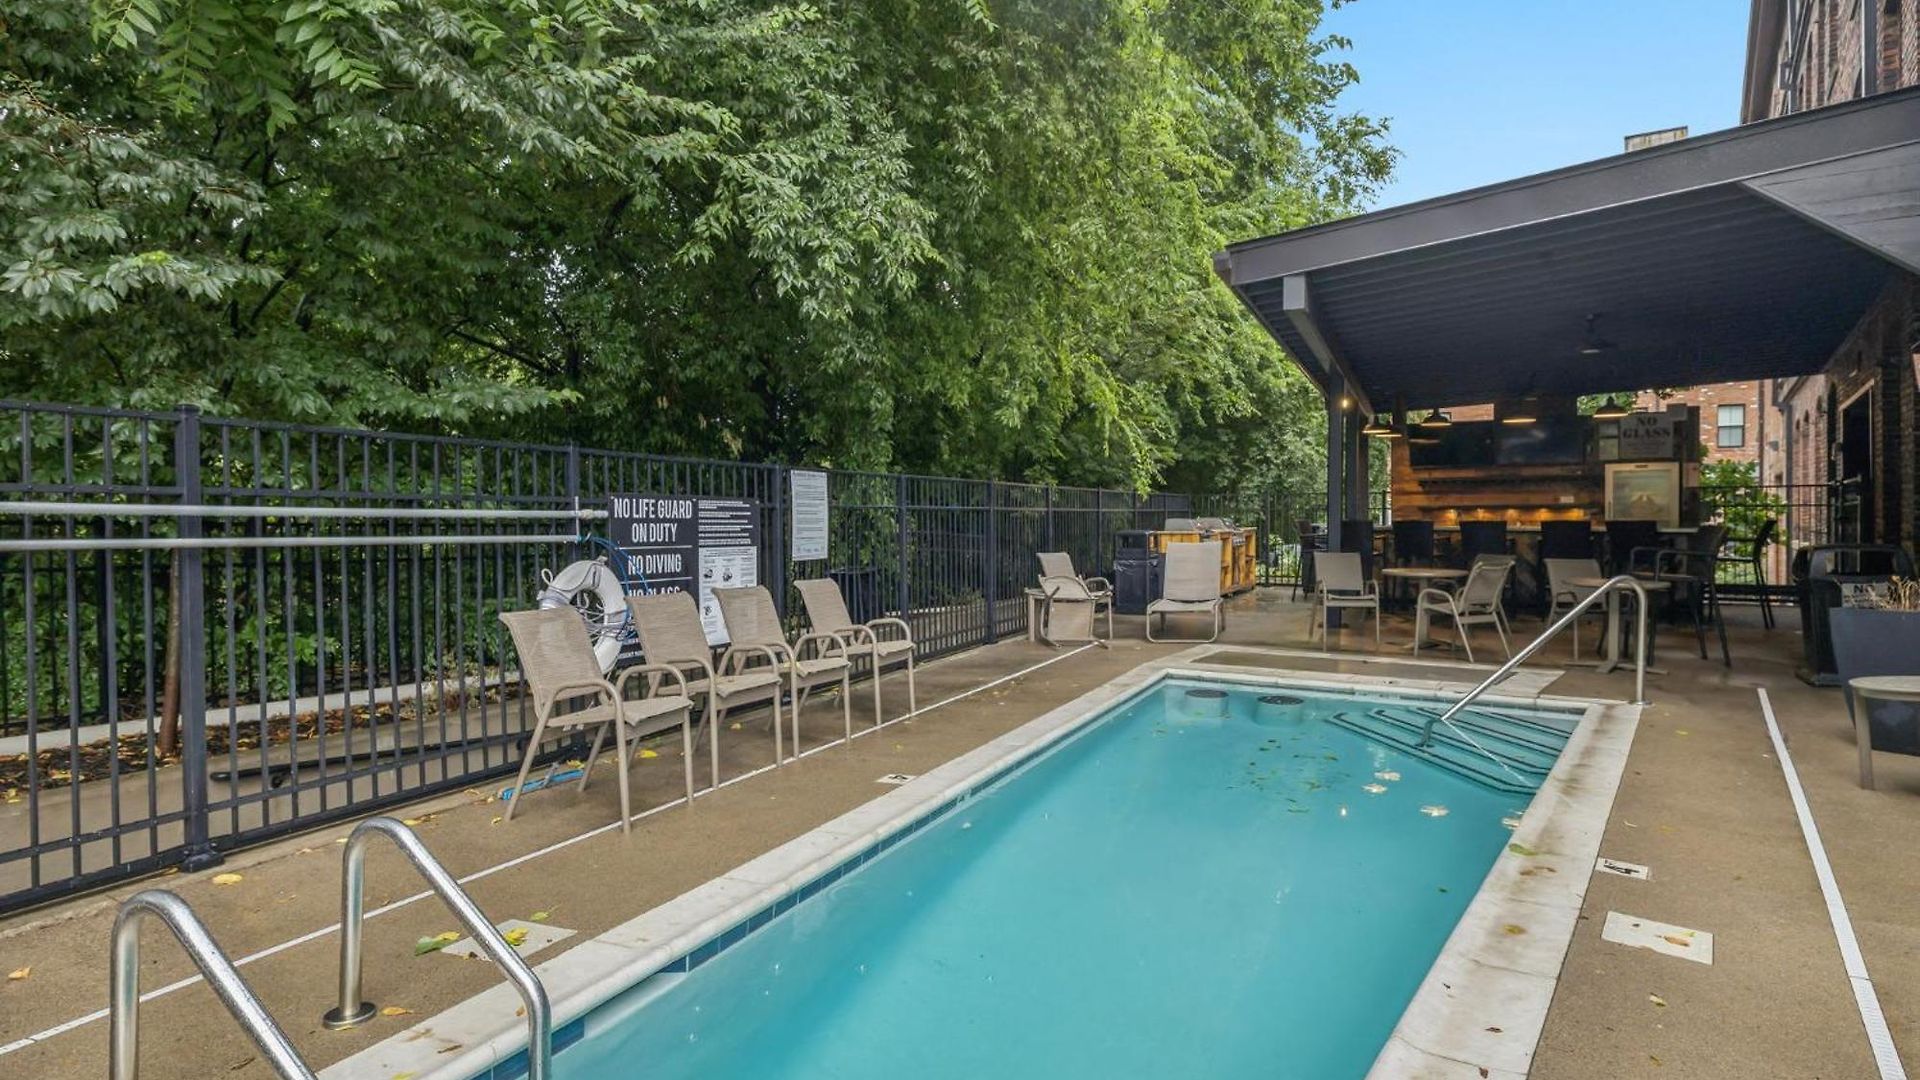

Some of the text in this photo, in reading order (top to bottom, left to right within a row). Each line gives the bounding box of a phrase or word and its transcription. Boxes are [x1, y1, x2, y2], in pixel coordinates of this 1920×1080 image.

[1637, 415, 1658, 426] NO
[1622, 427, 1671, 439] GLASS
[614, 498, 631, 519] NO
[633, 499, 656, 519] LIFE
[657, 500, 692, 519] GUARD
[632, 523, 677, 543] ON DUTY
[628, 555, 644, 576] NO
[645, 553, 682, 574] DIVING
